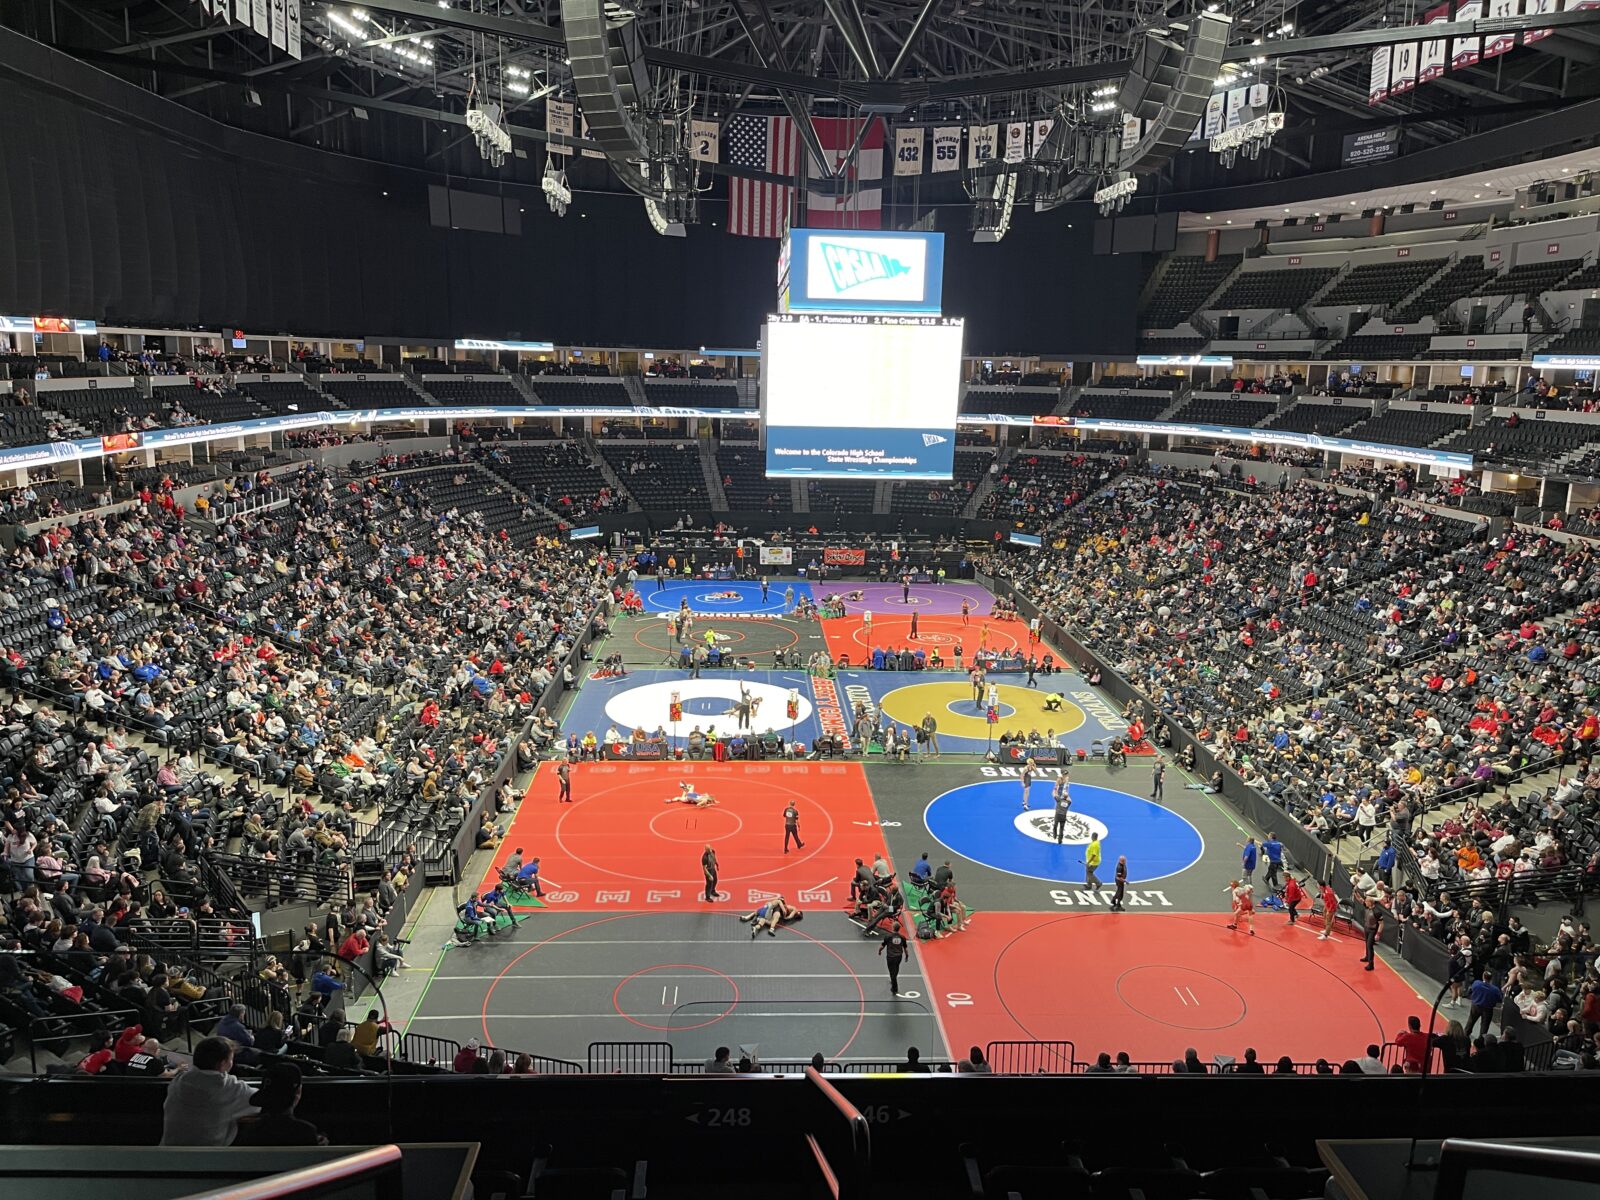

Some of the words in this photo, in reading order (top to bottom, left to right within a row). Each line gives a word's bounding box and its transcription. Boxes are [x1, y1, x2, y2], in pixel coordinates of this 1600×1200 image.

[1398, 48, 1410, 72] 19
[700, 140, 710, 155] 2
[899, 146, 919, 161] 432
[936, 145, 957, 160] 55
[975, 144, 992, 159] 12
[882, 317, 898, 325] Pine
[899, 317, 920, 325] Creek
[775, 448, 802, 456] Welcome
[850, 449, 864, 457] High
[864, 449, 885, 457] School
[844, 456, 873, 465] Wrestling
[873, 456, 917, 465] Championships
[657, 612, 783, 620] GNNISON
[636, 743, 660, 752] USA
[980, 766, 1064, 778] LYNS
[1049, 890, 1173, 906] LYONS
[946, 992, 975, 1008] 10
[707, 1108, 752, 1127] 248
